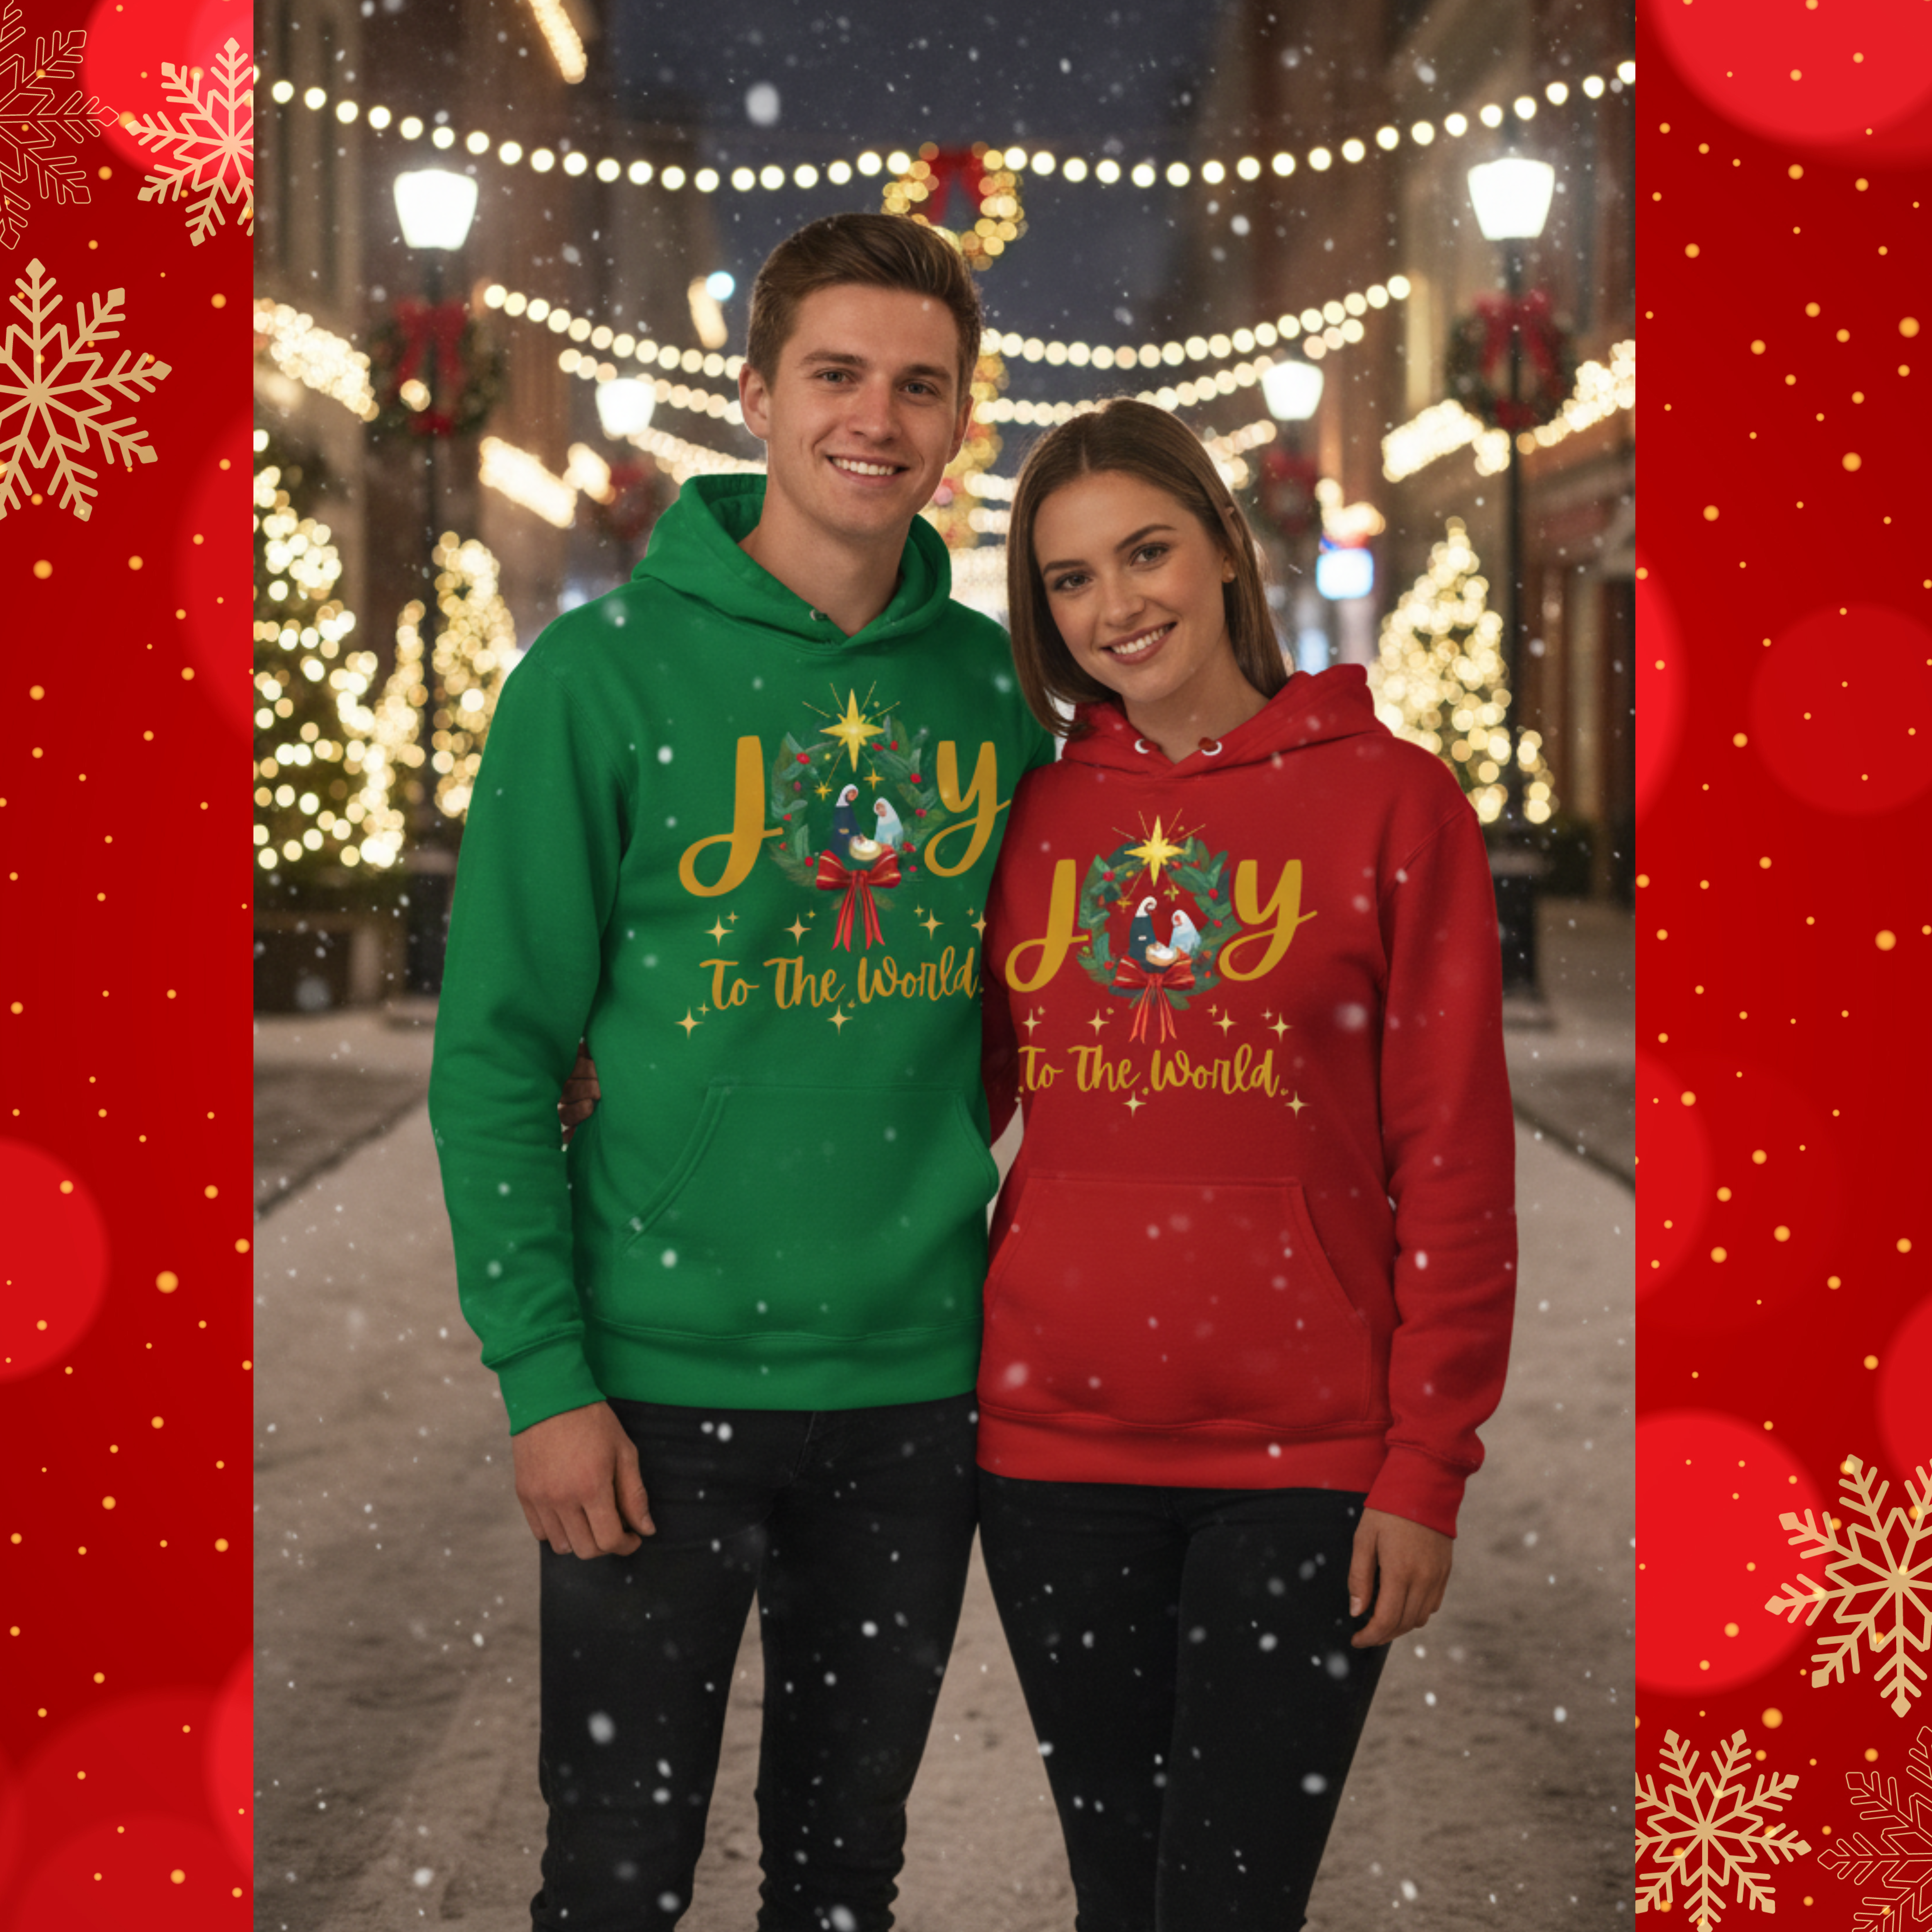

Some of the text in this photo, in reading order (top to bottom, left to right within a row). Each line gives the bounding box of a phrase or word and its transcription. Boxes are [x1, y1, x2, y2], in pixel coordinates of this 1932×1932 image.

[700, 959, 760, 1010] To
[764, 956, 845, 1009] The
[1019, 1045, 1063, 1091] To
[1068, 1044, 1140, 1092] The
